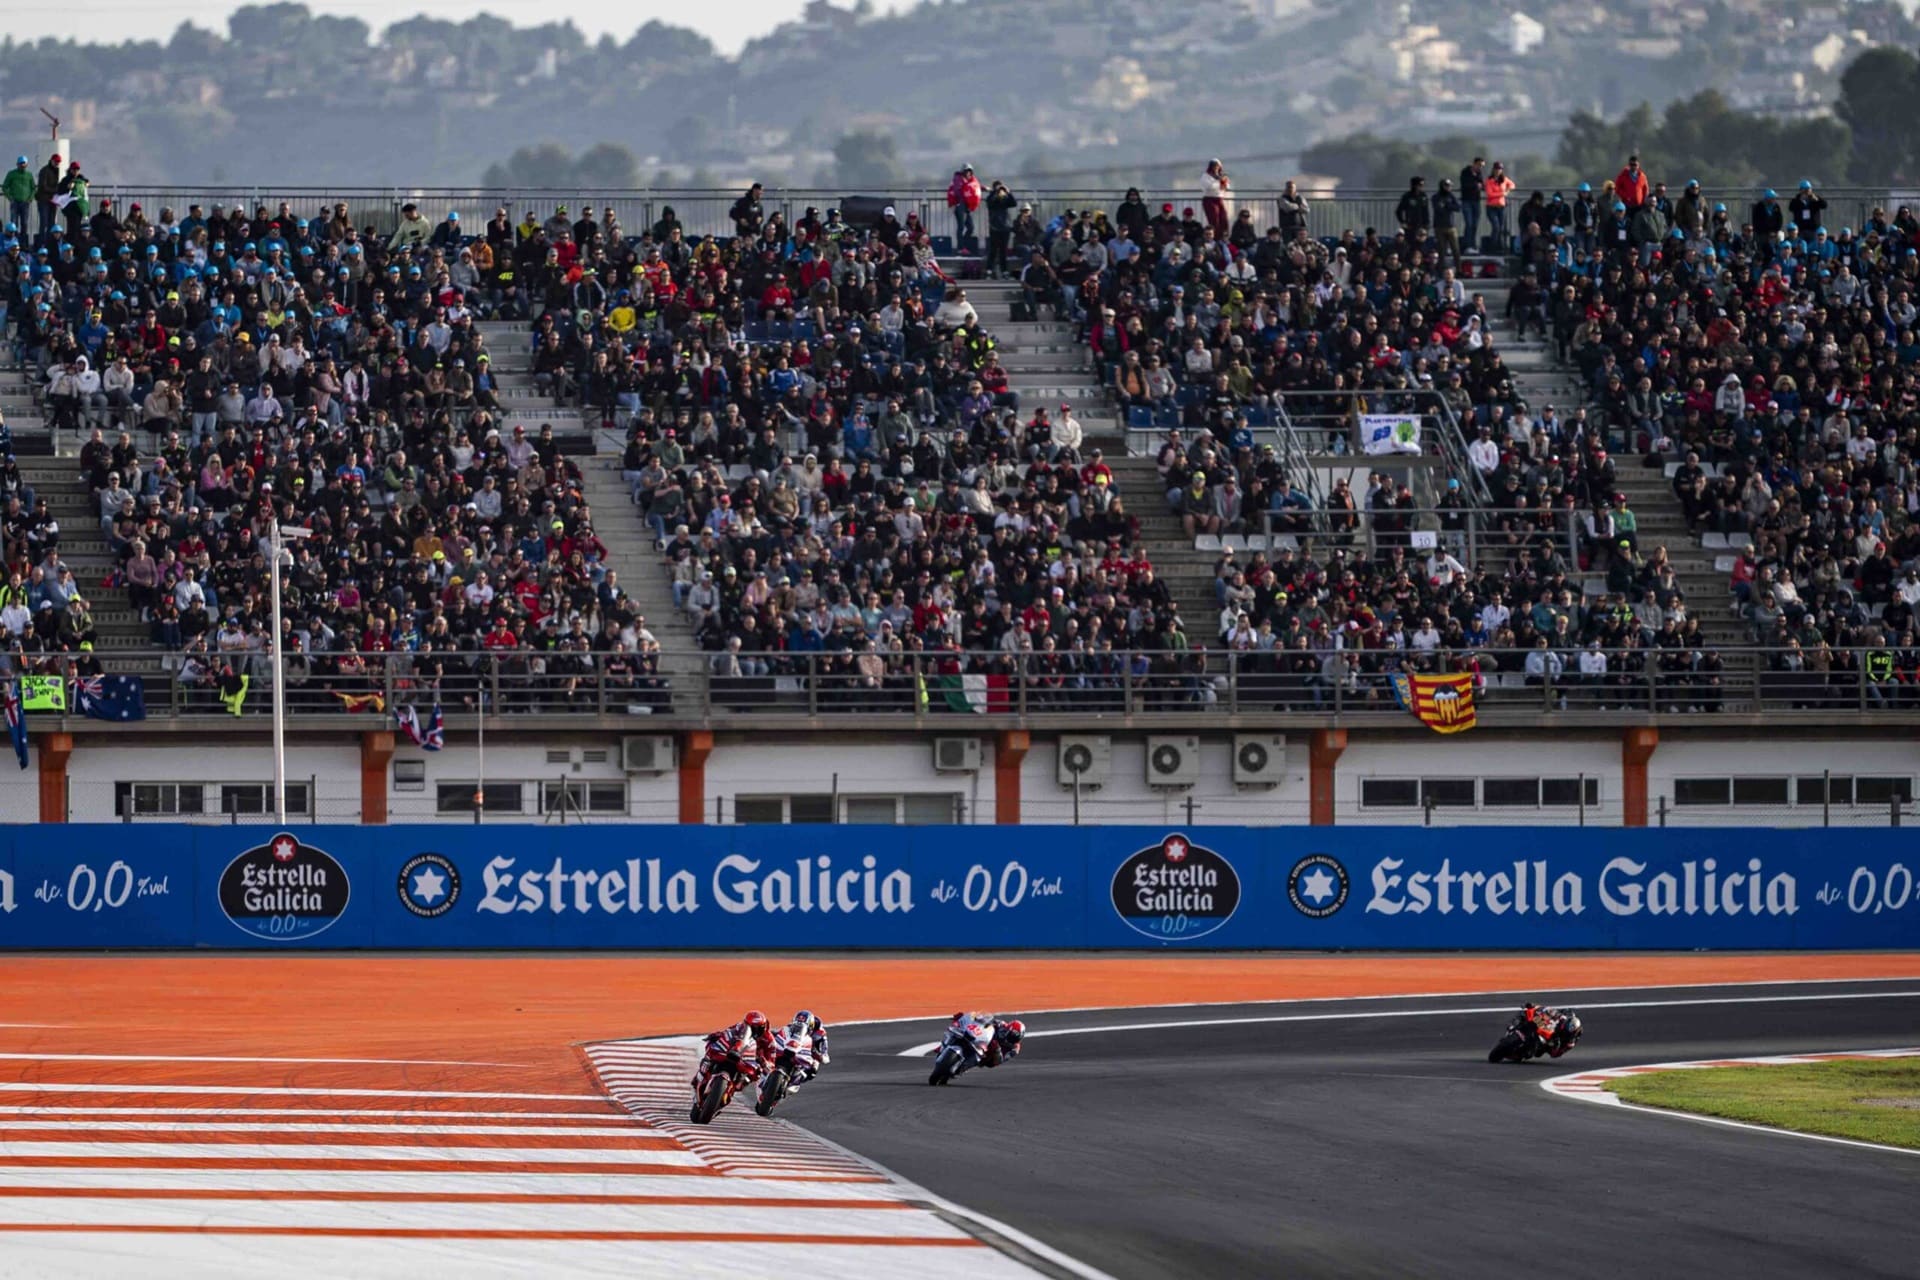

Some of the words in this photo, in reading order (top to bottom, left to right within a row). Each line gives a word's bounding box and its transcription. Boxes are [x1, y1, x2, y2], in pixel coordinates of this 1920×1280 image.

[34, 879, 62, 903] alc.
[67, 860, 133, 912] 0,0
[241, 863, 327, 887] Estrella
[476, 855, 700, 915] Estrella
[712, 854, 915, 914] Galicia
[931, 880, 960, 903] alc.
[963, 861, 1028, 912] 0,0
[1133, 863, 1218, 887] Estrella
[1365, 856, 1586, 915] Estrella
[1599, 857, 1800, 916] Galicia
[1848, 863, 1912, 914] 0,0
[244, 887, 322, 912] Galicia
[1136, 887, 1214, 912] Galicia
[270, 914, 296, 934] 0,0
[1162, 914, 1188, 934] 0,0
